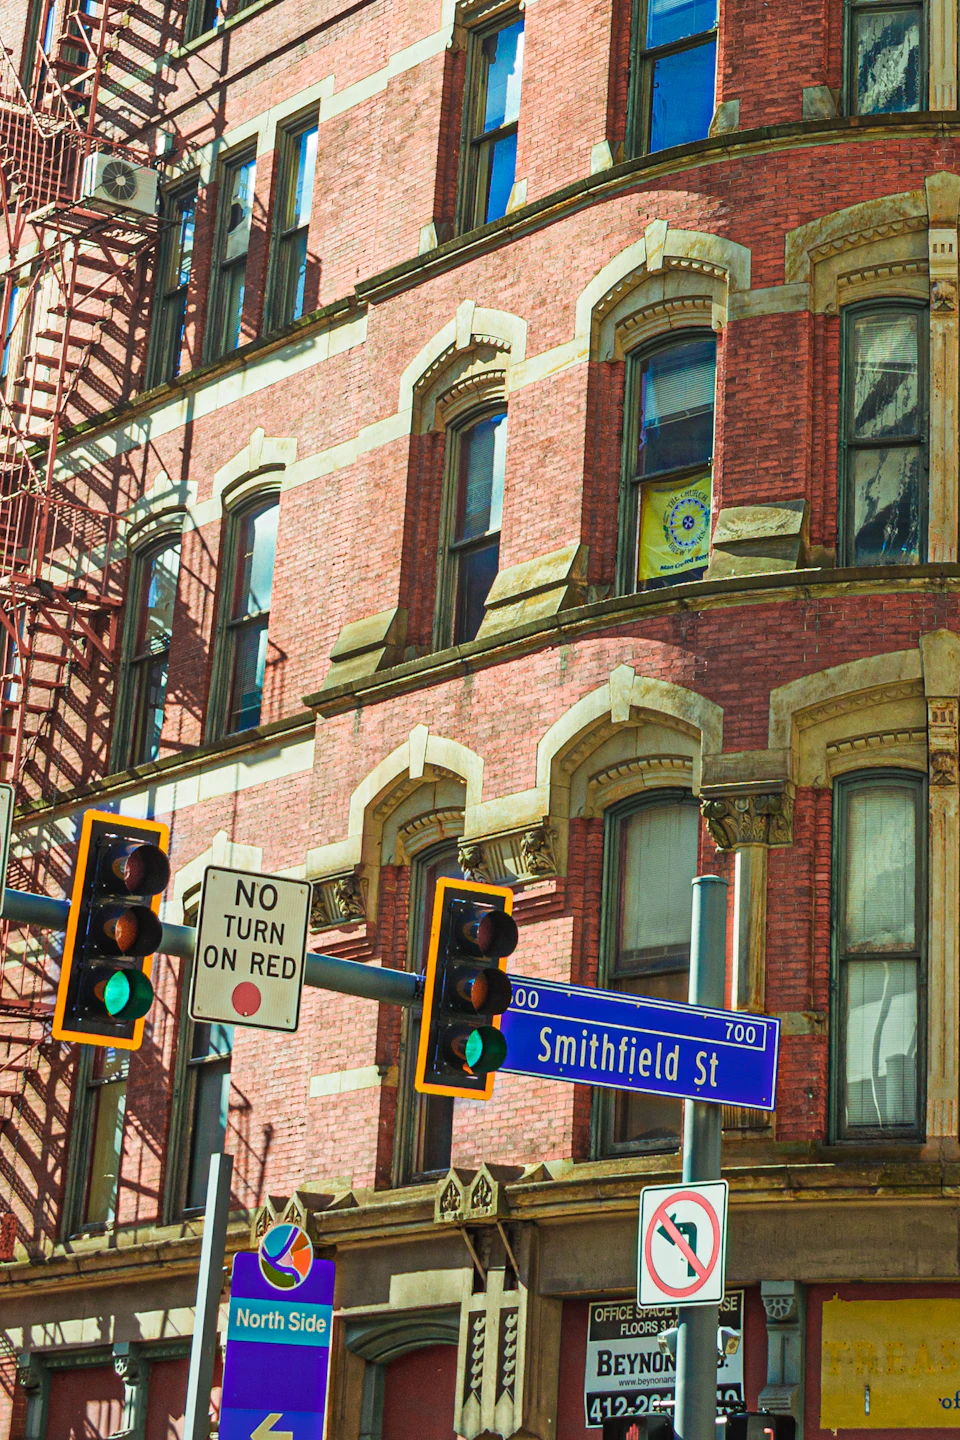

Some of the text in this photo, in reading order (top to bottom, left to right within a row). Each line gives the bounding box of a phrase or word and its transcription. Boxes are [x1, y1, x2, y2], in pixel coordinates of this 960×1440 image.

[666, 489, 709, 509] THE CHURCH
[235, 879, 278, 911] NO
[224, 914, 285, 946] TURN
[203, 945, 297, 980] ON RED
[510, 987, 756, 1044] 00 700
[537, 1026, 719, 1088] Smithfield St
[236, 1308, 327, 1333] North Side
[594, 1305, 634, 1322] OFFICE
[635, 1307, 672, 1319] SPACE
[620, 1321, 659, 1336] FLOORS
